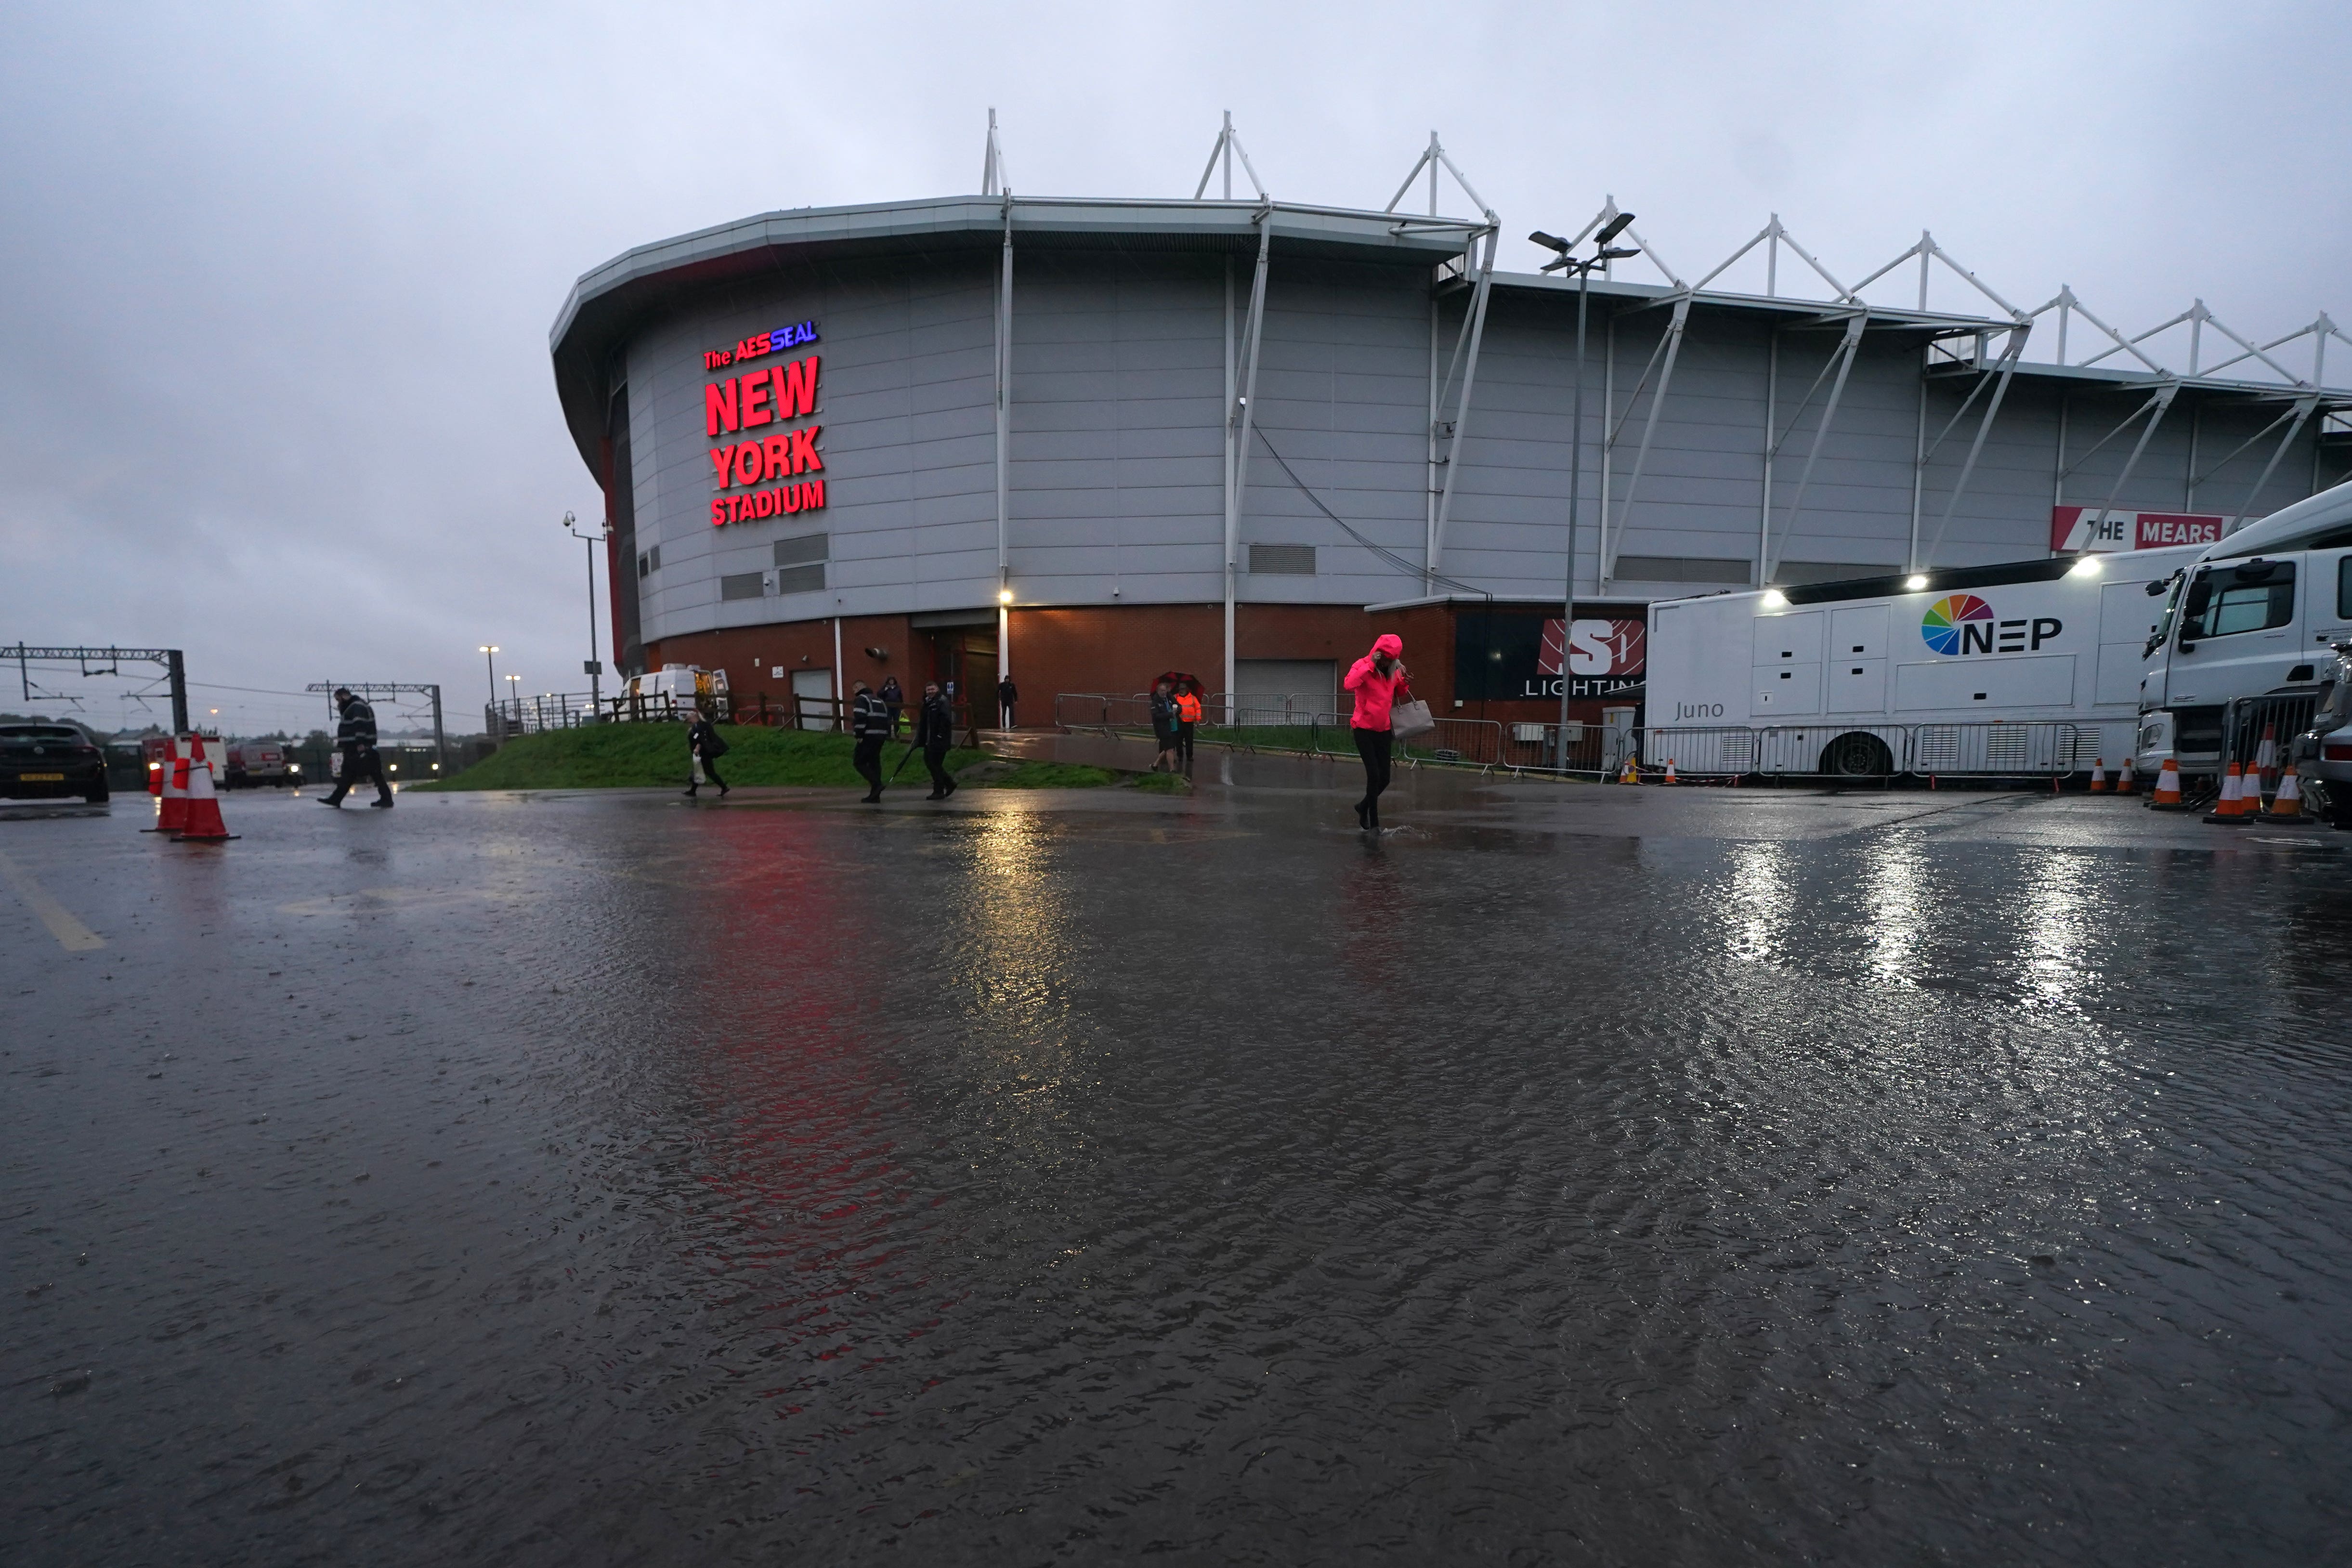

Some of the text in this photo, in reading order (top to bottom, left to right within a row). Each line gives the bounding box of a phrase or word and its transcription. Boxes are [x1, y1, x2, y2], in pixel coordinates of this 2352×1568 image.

[704, 321, 817, 369] The AESSEAL
[705, 356, 819, 436] NEW
[710, 426, 823, 488] YORK
[711, 480, 823, 525] STADIUM
[2142, 522, 2215, 543] MEARS
[1962, 618, 2063, 654] NEP
[1526, 680, 1646, 695] LIGHTIN
[1675, 702, 1724, 721] Juno
